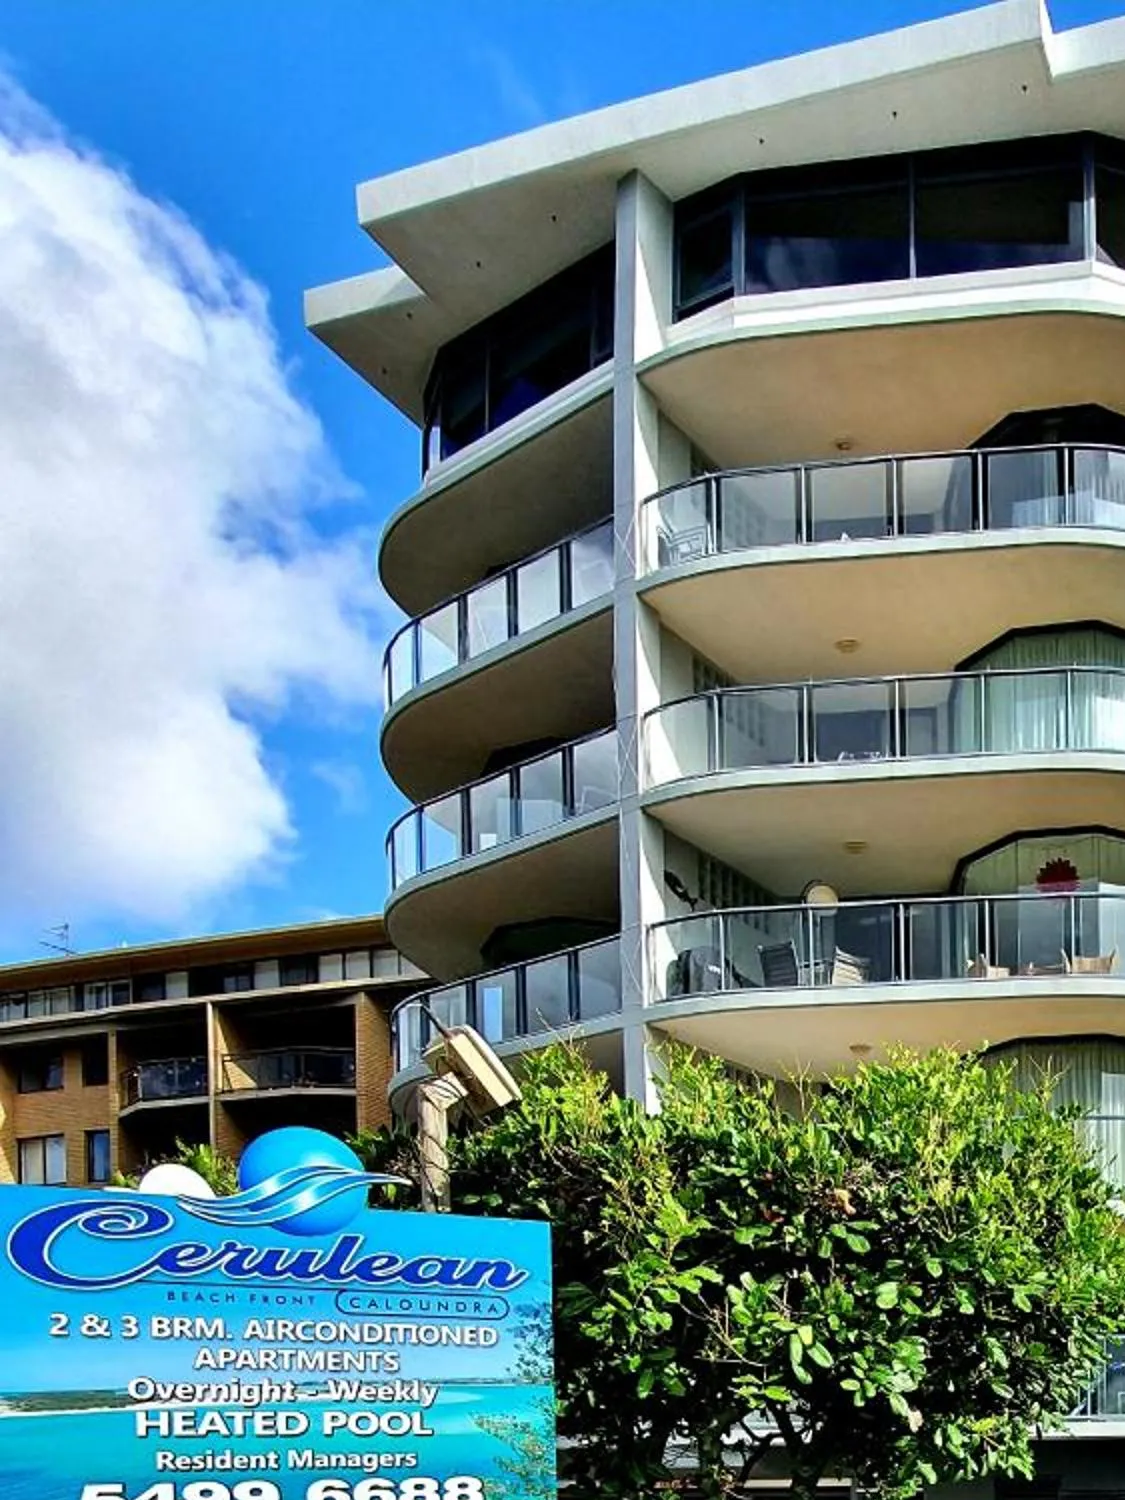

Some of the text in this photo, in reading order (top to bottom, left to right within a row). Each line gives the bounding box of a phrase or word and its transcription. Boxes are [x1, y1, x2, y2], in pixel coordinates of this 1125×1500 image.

[7, 1199, 530, 1291] Cerulean
[167, 1291, 499, 1315] BEACH FRONT CALOUNDRA
[49, 1313, 499, 1347] 2 & 3 BRM. AIRCONDITIONED
[194, 1347, 400, 1373] APARTMENTS
[127, 1376, 296, 1408] Overnight
[327, 1380, 439, 1412] Weekly
[135, 1410, 434, 1438] HEATED POOL
[156, 1449, 418, 1474] Resident Managers
